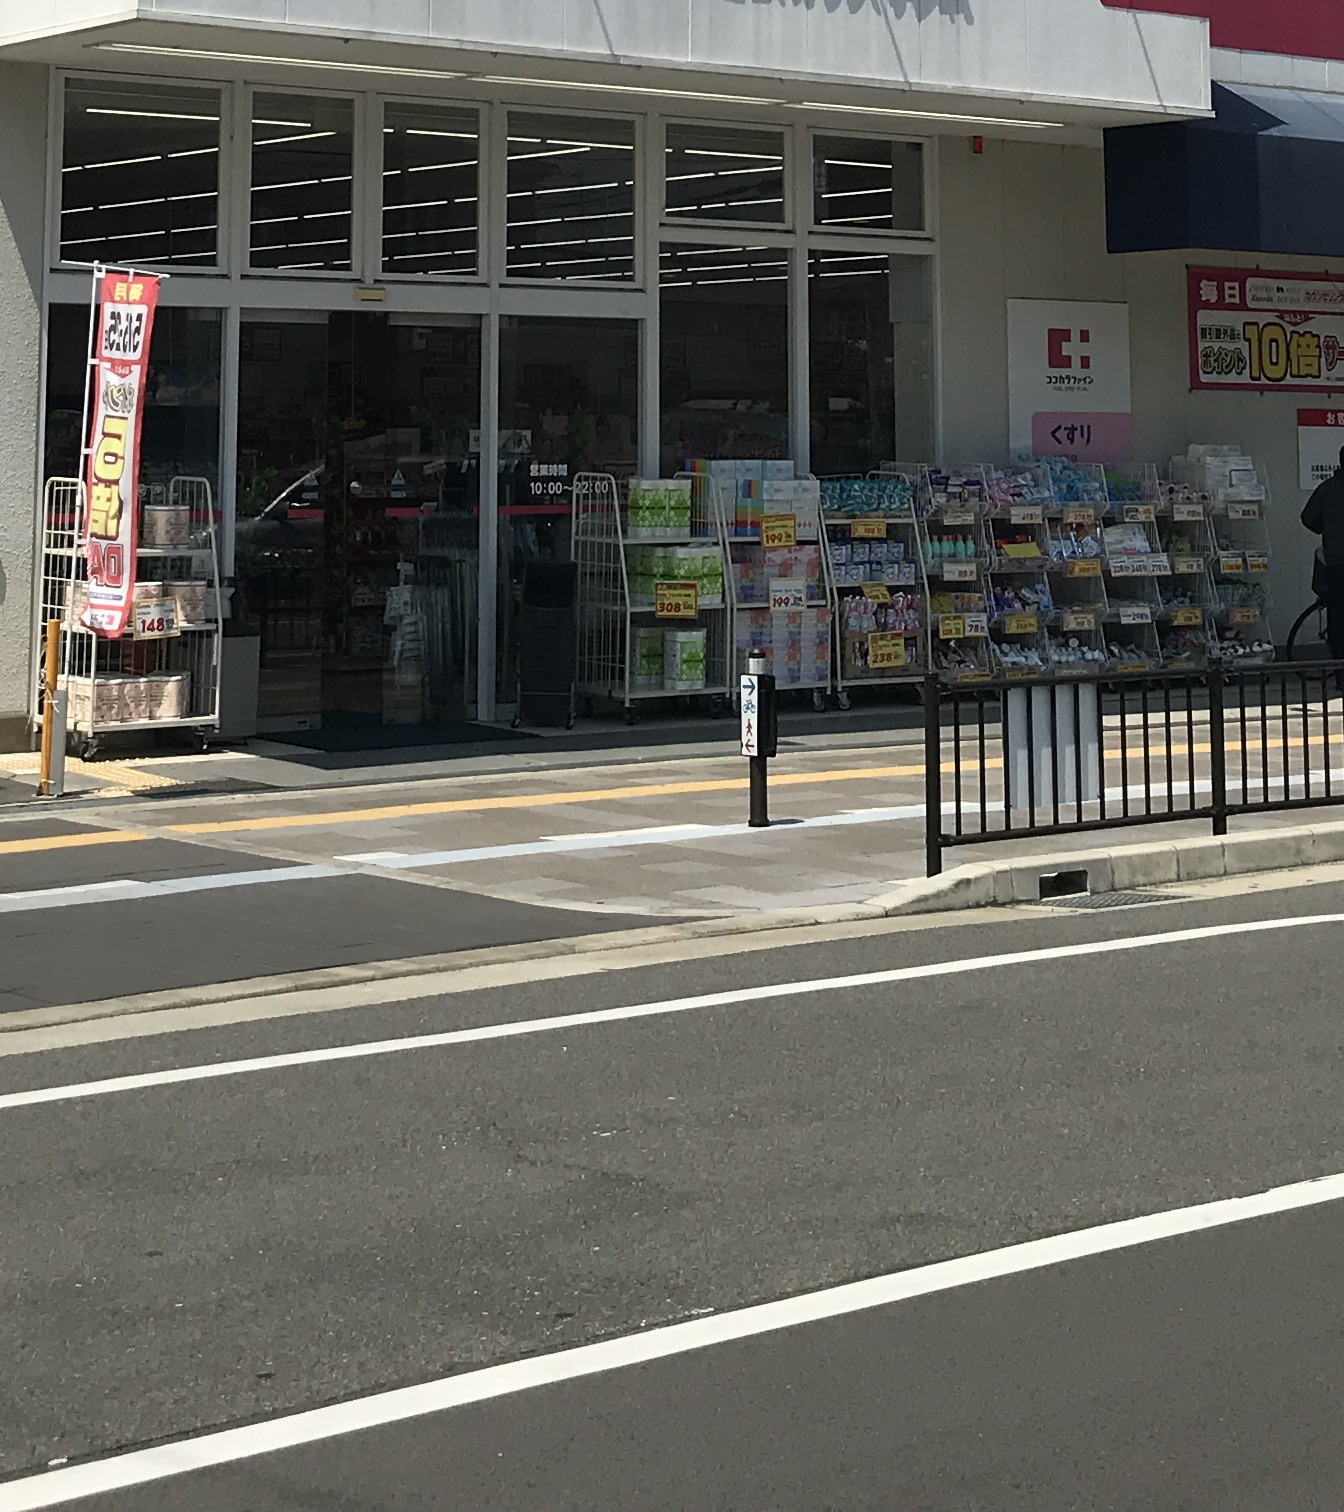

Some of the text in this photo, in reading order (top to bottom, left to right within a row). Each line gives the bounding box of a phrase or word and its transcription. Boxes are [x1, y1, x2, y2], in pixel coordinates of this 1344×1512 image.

[1199, 279, 1241, 304] 毎日
[1200, 345, 1247, 375] ポイント
[1243, 321, 1322, 382] 10倍
[1045, 374, 1094, 385] ココカラファイン
[1050, 424, 1092, 445] くすり
[765, 533, 783, 544] 199
[658, 602, 682, 613] 308
[772, 597, 790, 608] 199
[140, 617, 165, 634] 148
